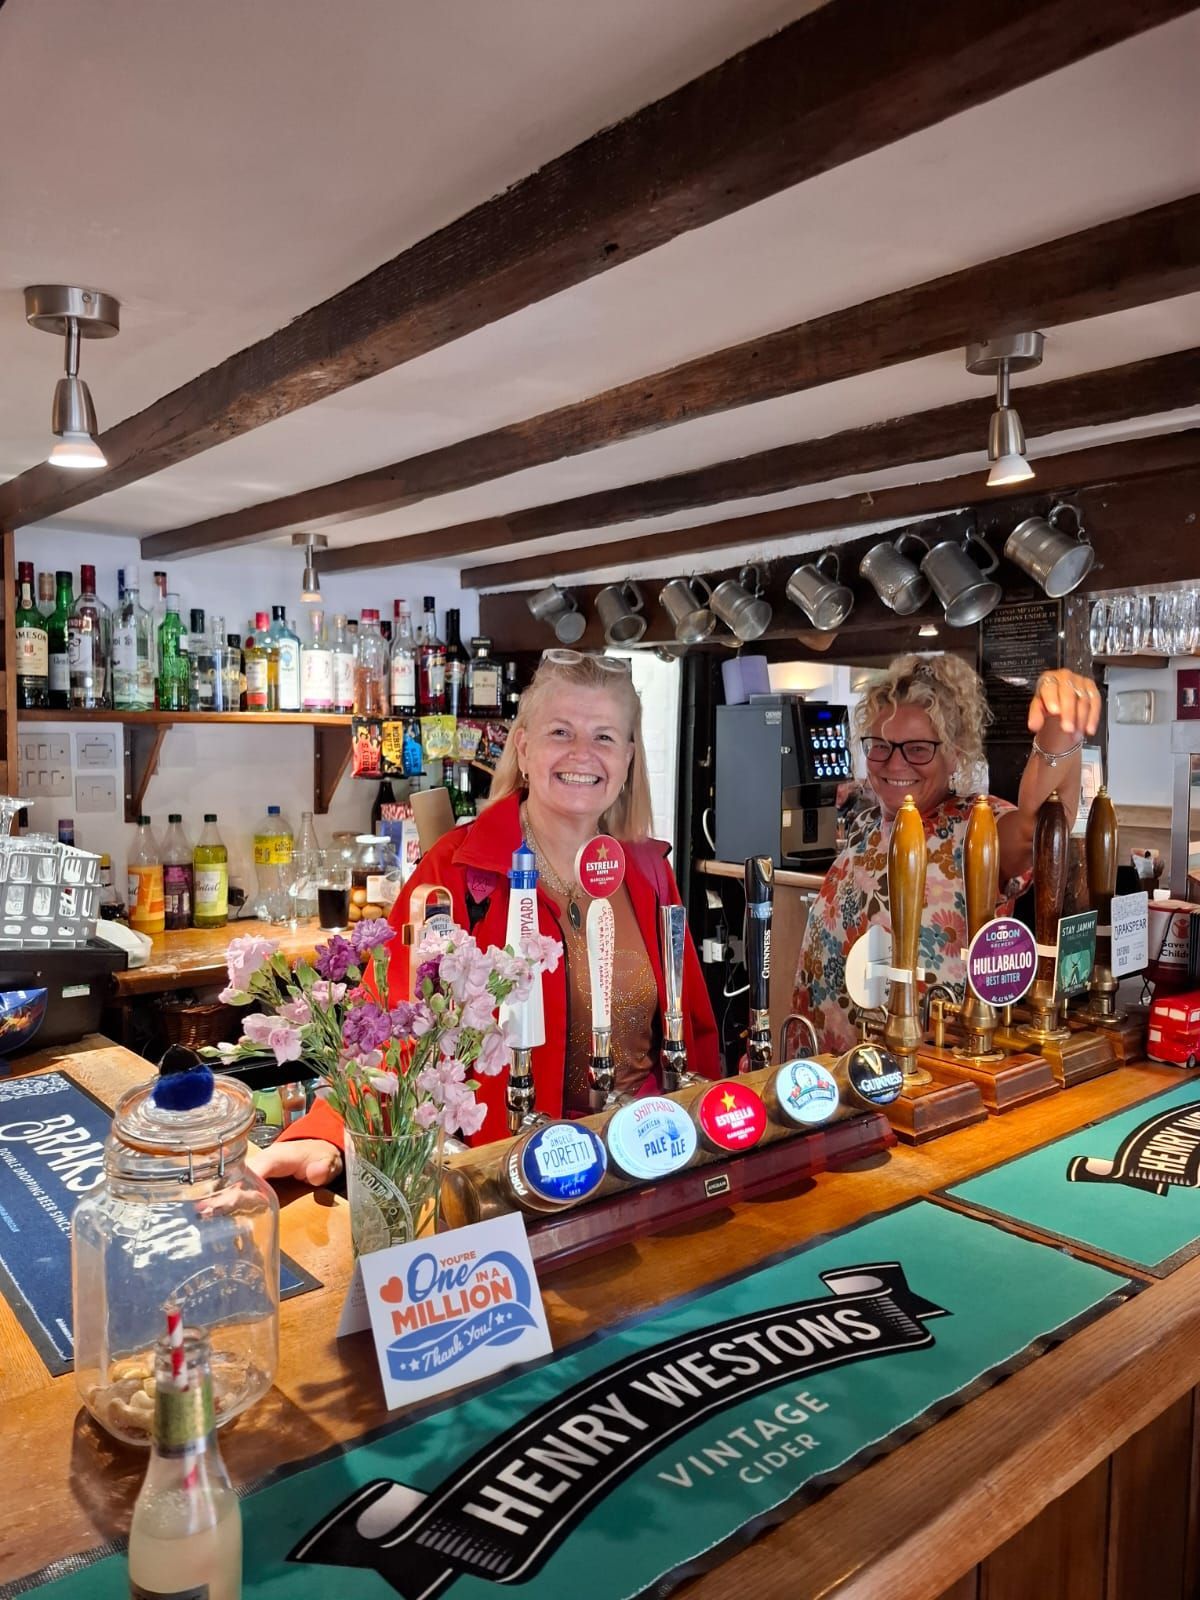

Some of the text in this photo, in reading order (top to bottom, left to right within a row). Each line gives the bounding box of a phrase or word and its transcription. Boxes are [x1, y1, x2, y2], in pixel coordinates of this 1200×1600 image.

[16, 631, 47, 641] AMESON
[586, 860, 619, 872] ESTRELLA
[520, 897, 534, 938] IPYARD
[1062, 925, 1076, 937] STAY
[761, 929, 772, 980] GUINNESS
[973, 951, 1032, 976] HULLABALOO
[985, 972, 1021, 987] BEST BITTER
[860, 1072, 903, 1093] GUINNESS
[634, 1101, 675, 1122] SHIPYARD
[715, 1105, 755, 1128] ESTRELLA
[0, 1114, 107, 1199] BRAKS
[542, 1140, 591, 1171] PORETTI
[644, 1136, 668, 1158] PALE
[670, 1138, 686, 1158] ALE
[1138, 1126, 1200, 1175] HENRY
[508, 1153, 529, 1196] PORETTI
[13, 1167, 46, 1197] DROPPING
[36, 1195, 59, 1212] BEER
[49, 1210, 72, 1232] SINCE
[440, 1250, 477, 1268] YOU'RE
[475, 1267, 501, 1283] IN A
[406, 1252, 471, 1303] One
[391, 1277, 513, 1336] MILLION
[421, 1311, 494, 1373] Thank You!
[462, 1308, 882, 1537] HENRY WESTONS
[657, 1390, 831, 1490] VINTAGE
[738, 1432, 822, 1485] CIDER
